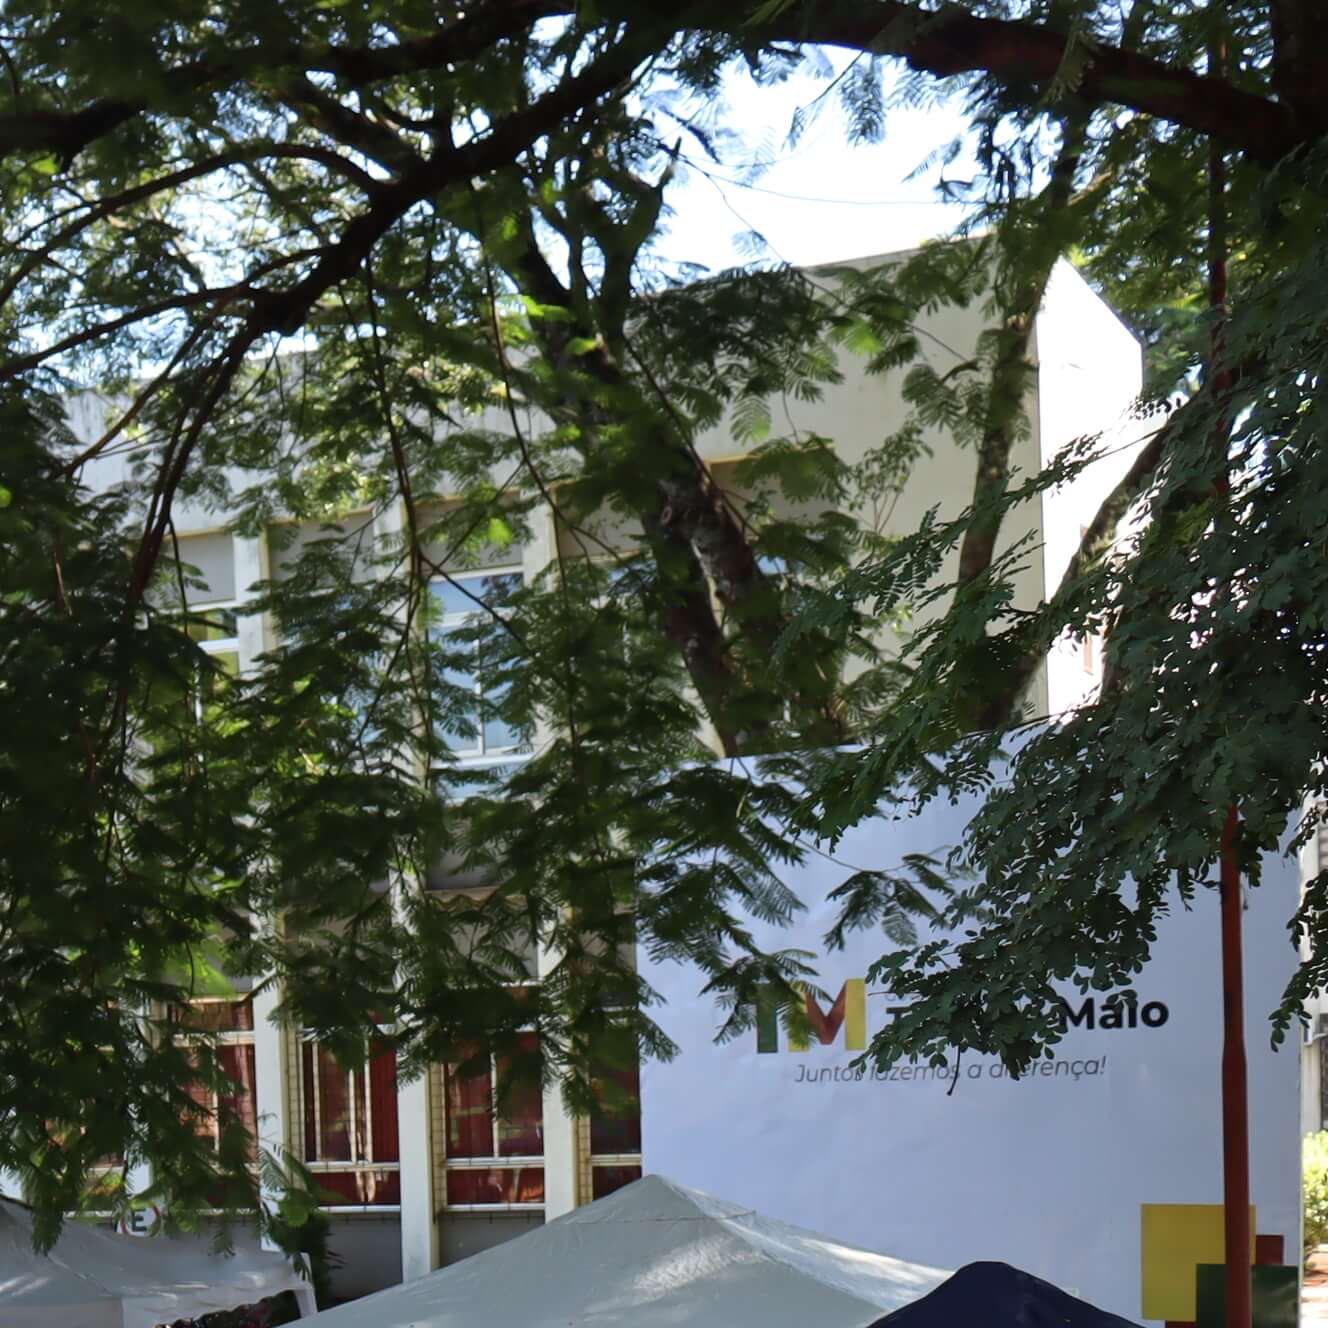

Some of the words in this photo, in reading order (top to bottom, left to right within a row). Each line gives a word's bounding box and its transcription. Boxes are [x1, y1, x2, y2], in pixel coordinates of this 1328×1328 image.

[1061, 996, 1169, 1029] Maio
[968, 1064, 983, 1079] a
[989, 1056, 1106, 1080] dierença!
[132, 1207, 147, 1232] E
